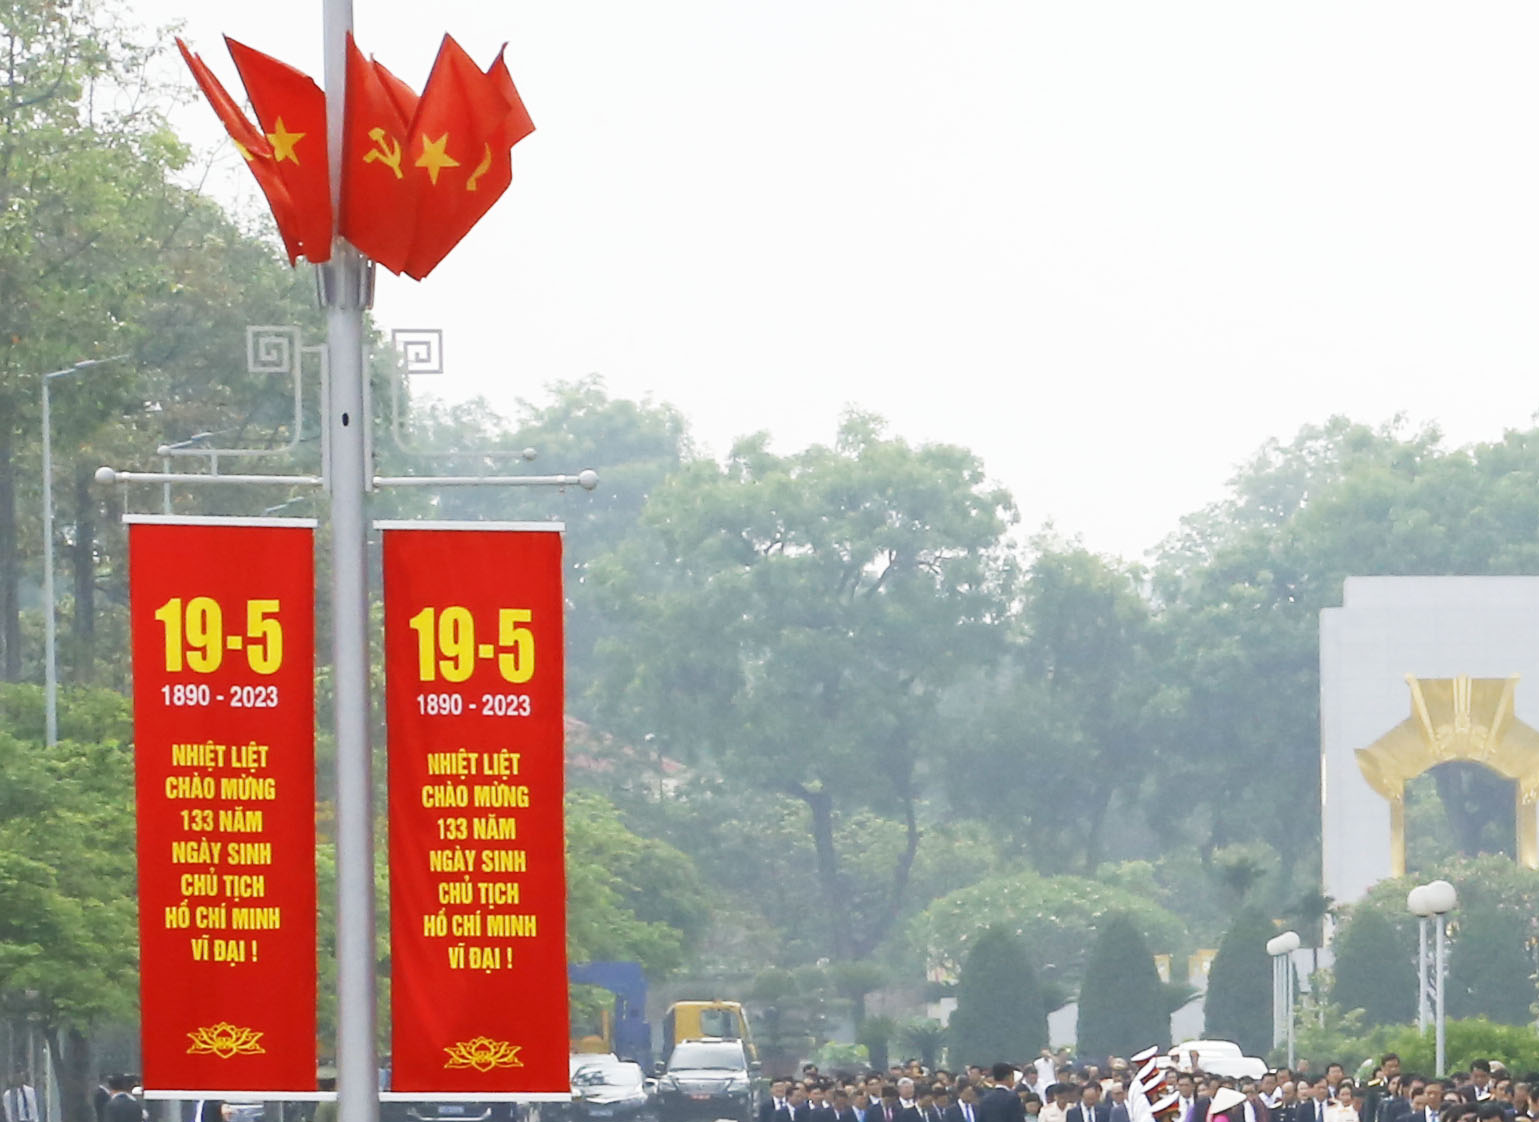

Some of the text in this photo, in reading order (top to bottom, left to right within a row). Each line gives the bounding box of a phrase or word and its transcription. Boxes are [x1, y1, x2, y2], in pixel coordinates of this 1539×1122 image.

[154, 596, 284, 675] 19-5
[408, 605, 536, 684] 19-5
[160, 684, 211, 706] 1890
[229, 685, 279, 708] 2023
[416, 693, 463, 715] 1890
[481, 694, 531, 717] 2023
[171, 739, 269, 773] NHIỆT LIỆT
[427, 747, 521, 781] NHIỆT LIỆT
[165, 771, 276, 801] CHÀO MỪNG
[421, 780, 530, 808] CHÀO MỪNG
[180, 805, 263, 833] 133 NĂM
[437, 813, 517, 841] 133 NĂM
[171, 836, 272, 866] NGÀY SINH
[429, 844, 527, 873] NGÀY SINH
[180, 866, 265, 903] CHỦ TỊCH
[438, 874, 520, 910] CHỦ TỊCH
[195, 902, 227, 930] CHÍ
[231, 906, 281, 931] MINH
[451, 909, 482, 938] CHÍ
[486, 914, 537, 938] MINH
[190, 934, 258, 968] VĨ ĐẠI !
[447, 942, 513, 975] VĨ ĐẠI !
